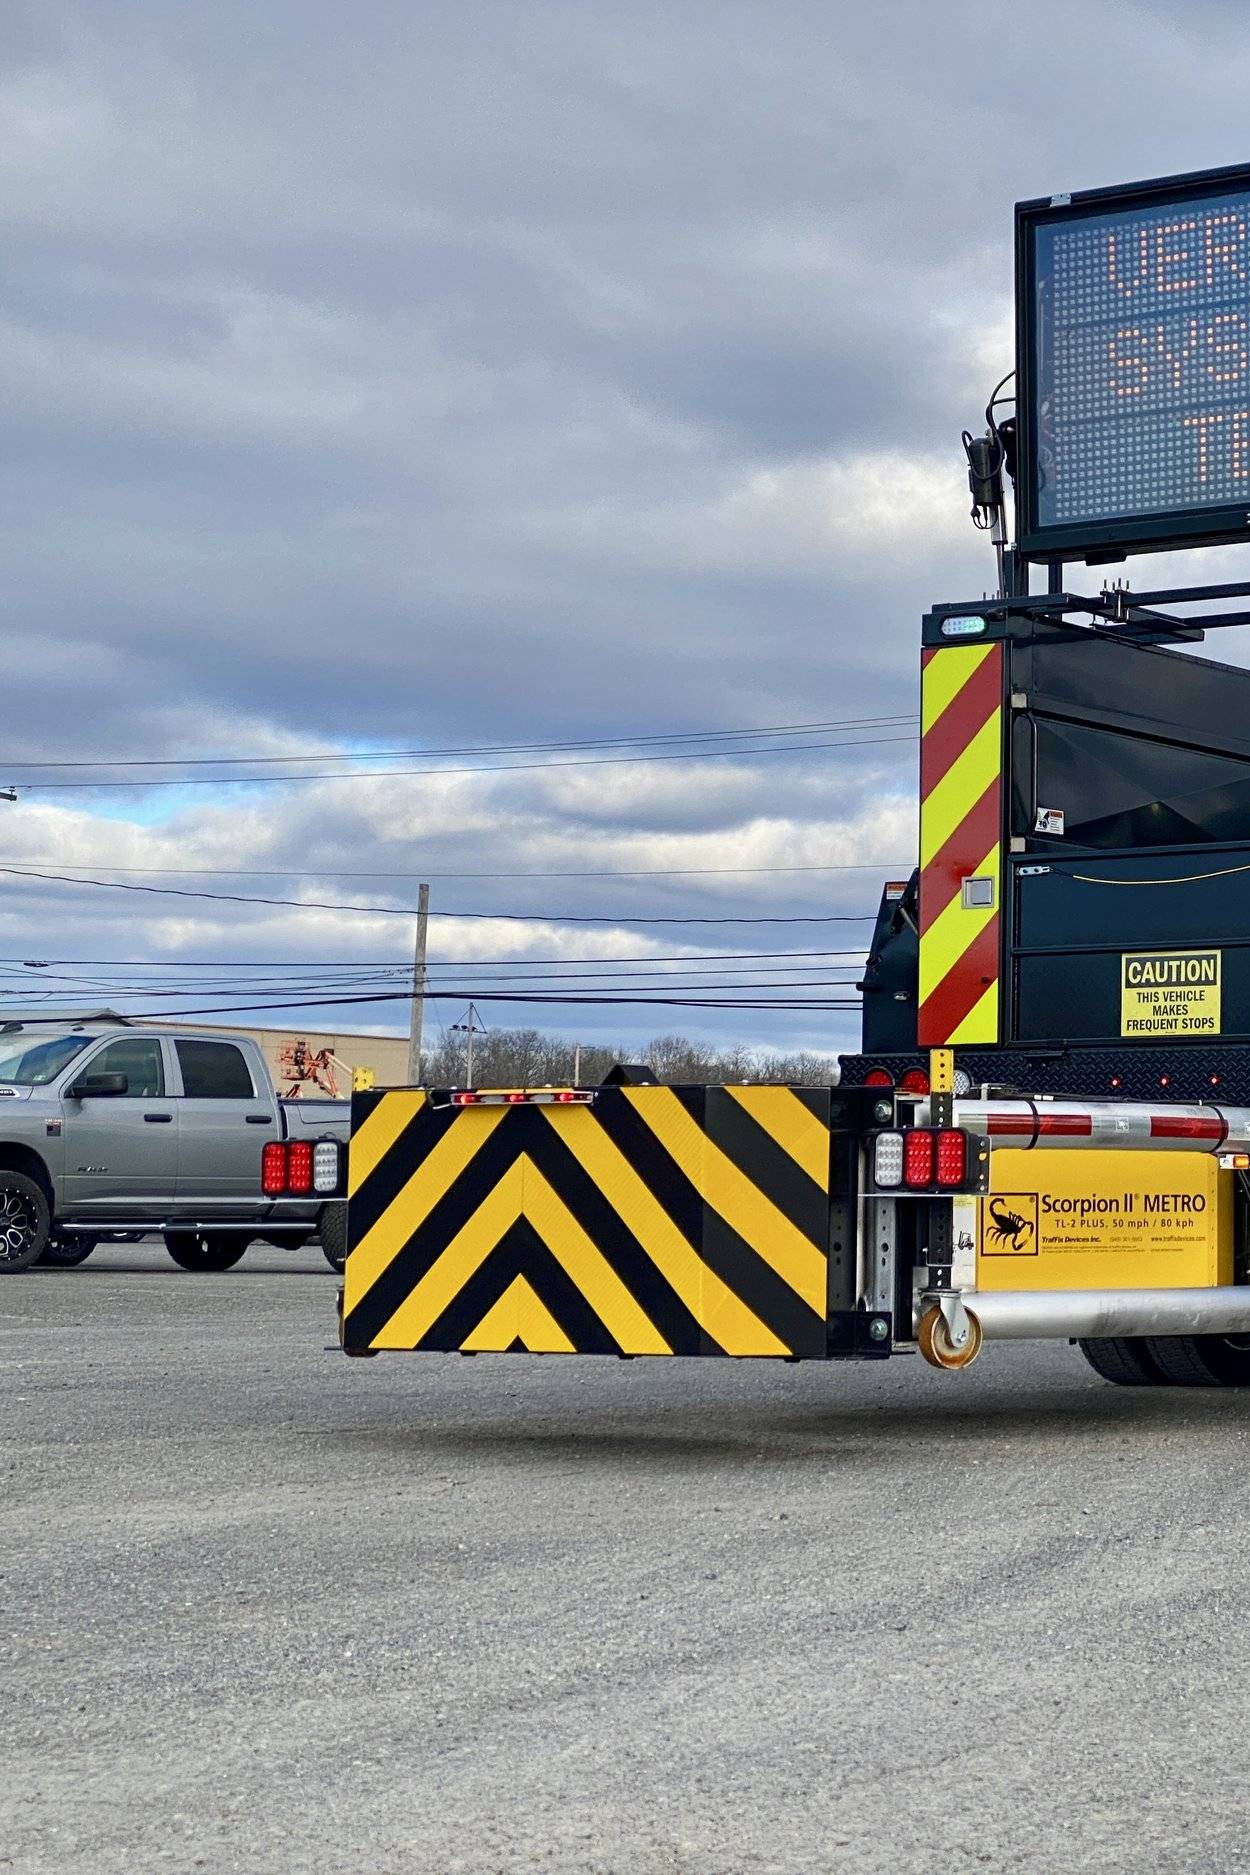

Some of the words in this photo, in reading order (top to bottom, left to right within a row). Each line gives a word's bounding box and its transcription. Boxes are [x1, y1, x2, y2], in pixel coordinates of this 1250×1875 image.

[1128, 959, 1215, 984] CAUTION
[1136, 991, 1160, 1003] THIS
[1163, 990, 1206, 1002] VEHICLE
[1152, 1004, 1189, 1016] MAKES
[1126, 1018, 1179, 1032] FREQUENT
[1181, 1017, 1215, 1029] STOPS
[1041, 1194, 1120, 1217] Scorpion
[1144, 1193, 1206, 1213] METRO
[1055, 1219, 1076, 1228] TL-2
[1080, 1219, 1108, 1229] PLUS,
[1112, 1218, 1124, 1228] 50
[1127, 1219, 1149, 1230] mph
[1160, 1218, 1173, 1228] 80
[1176, 1218, 1194, 1229] kph
